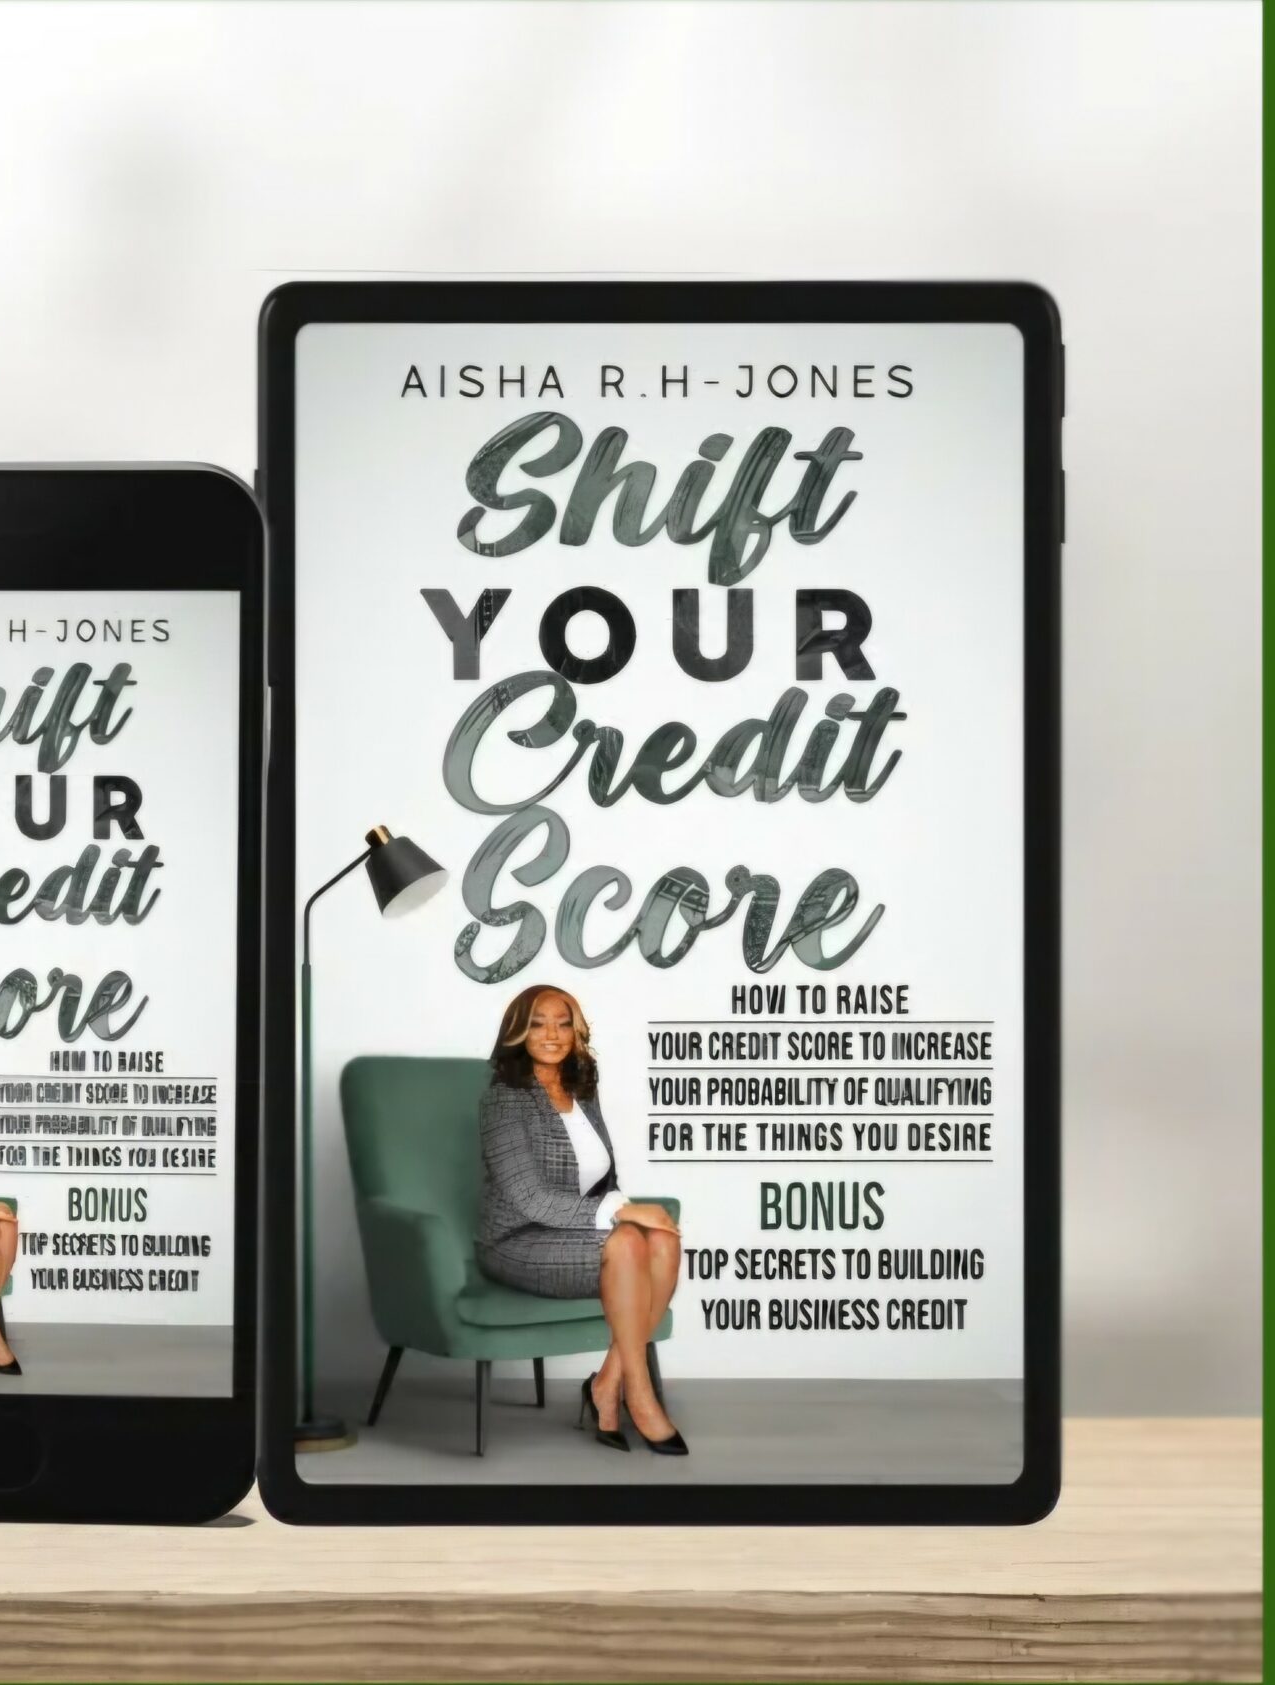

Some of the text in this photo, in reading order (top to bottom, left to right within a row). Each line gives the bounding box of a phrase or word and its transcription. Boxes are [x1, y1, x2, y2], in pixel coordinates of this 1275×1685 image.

[401, 365, 913, 398] AISHA R.H-JONES
[457, 411, 863, 587] Shift
[420, 585, 876, 685] YOUR
[442, 670, 907, 816] Credit
[454, 804, 886, 984] Score
[732, 985, 909, 1014] HOW TO RAISE
[648, 1032, 992, 1060] YOUR CREDIT SCORE TO INCREASE
[649, 1077, 991, 1106] YOUR PROBABILITY OF QUALIFYING
[649, 1123, 991, 1151] FOR THE THINGS YOU DESIRE
[68, 1187, 147, 1222] BONUS
[760, 1181, 885, 1231] BONUS
[684, 1249, 984, 1280] TOP SECRETS TO BUILDING
[701, 1299, 967, 1330] YOUR BUSINESS CREDIT
